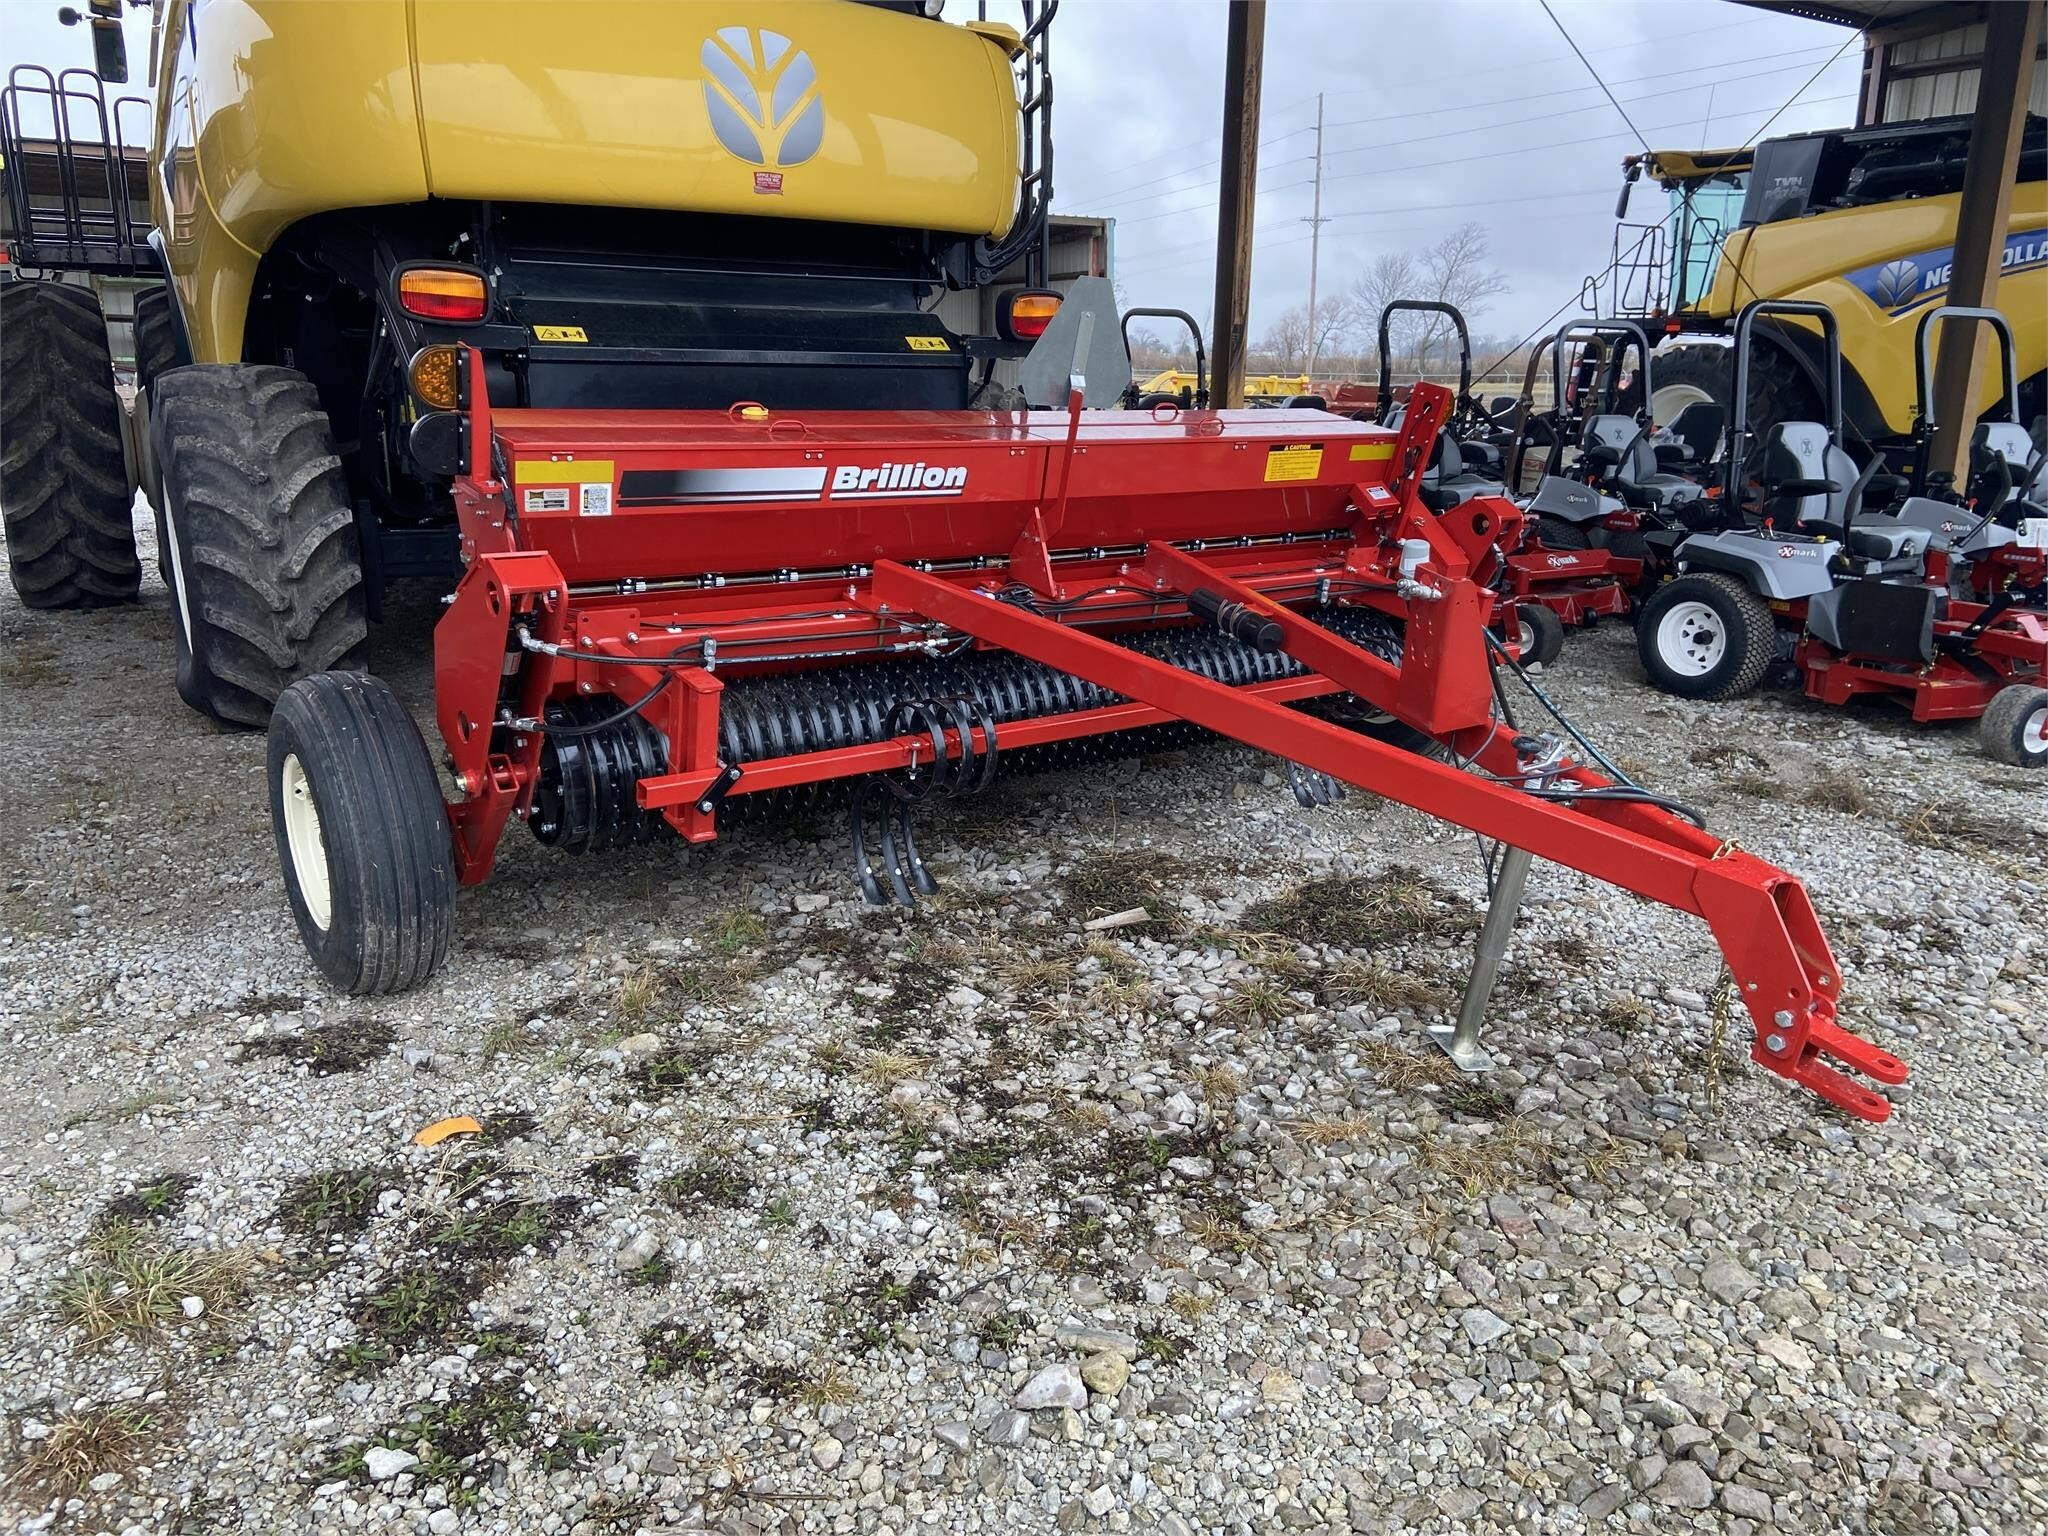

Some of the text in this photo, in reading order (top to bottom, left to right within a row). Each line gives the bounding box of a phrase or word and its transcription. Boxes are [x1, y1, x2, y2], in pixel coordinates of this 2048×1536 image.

[1774, 177, 1802, 186] TWIN
[1925, 241, 2048, 289] NE OLLA
[832, 463, 967, 490] Brillion
